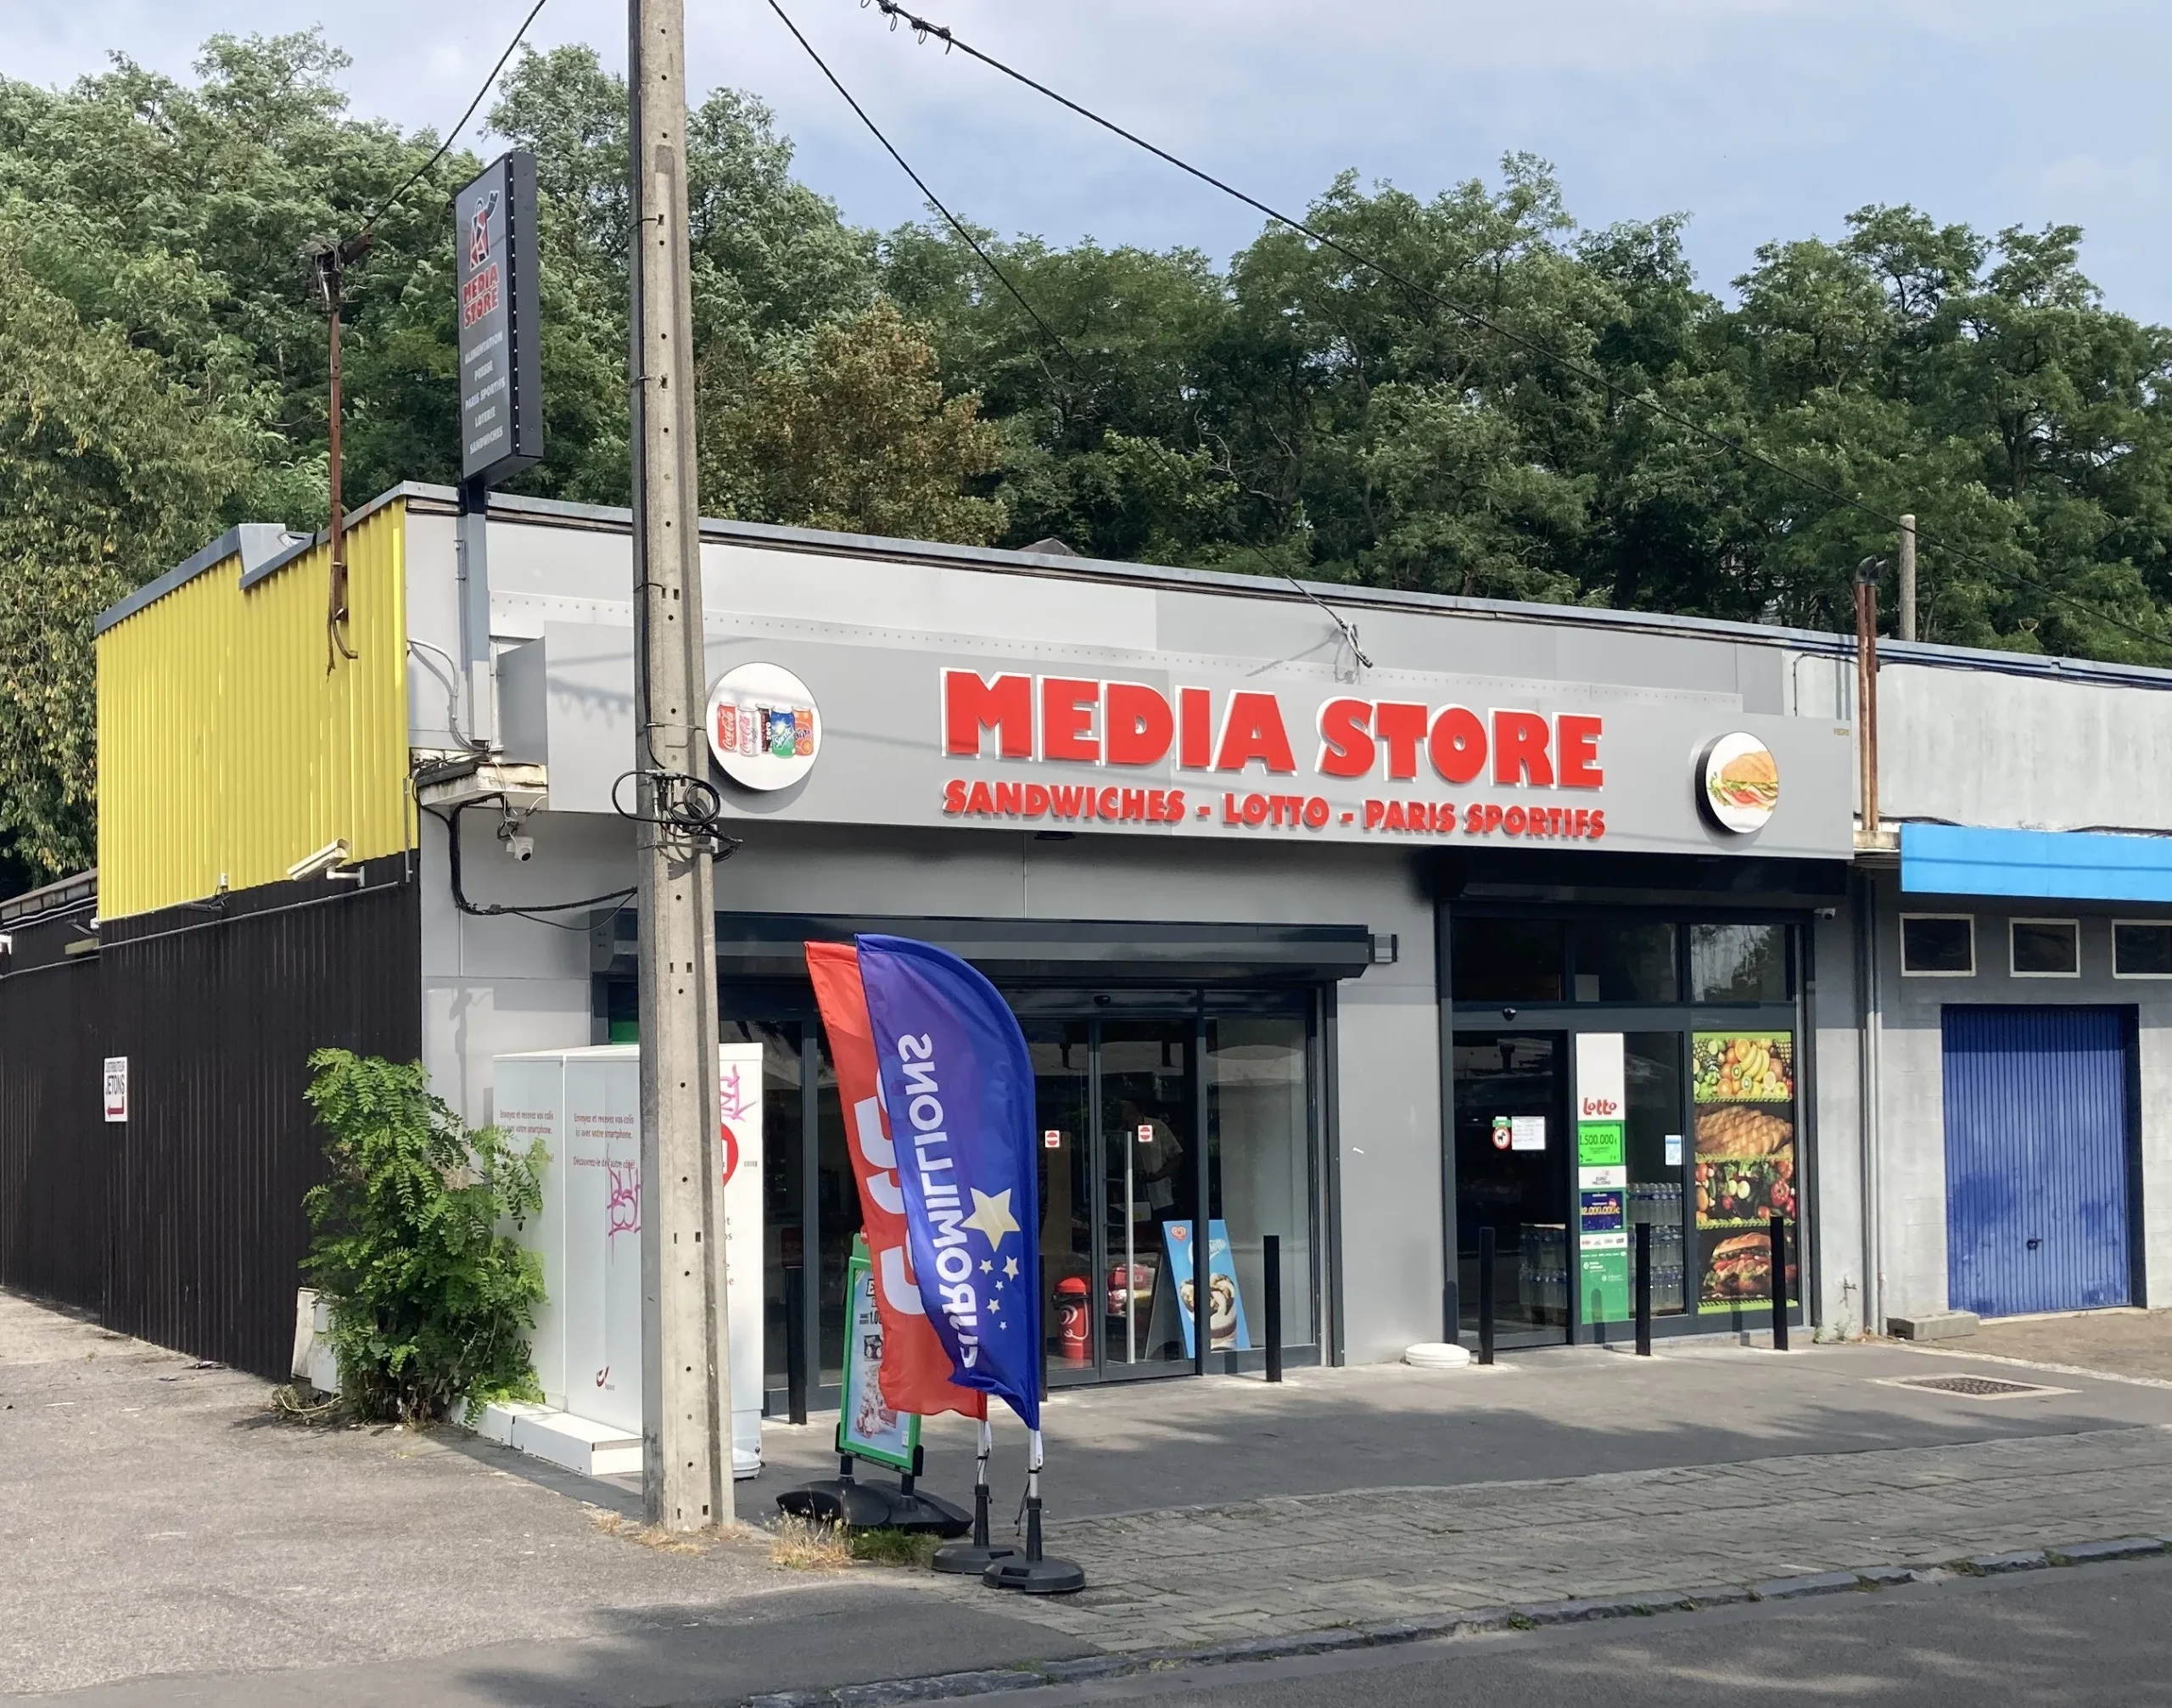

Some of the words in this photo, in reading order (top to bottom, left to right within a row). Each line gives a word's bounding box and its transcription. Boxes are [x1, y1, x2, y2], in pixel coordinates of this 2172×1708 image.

[462, 262, 500, 307] MEDIA
[463, 284, 500, 329] STORE
[465, 330, 502, 365] ALIMENTATION
[474, 360, 492, 381] PRESSE
[465, 392, 479, 411] PARIS
[480, 377, 505, 401] SPORTIFS
[475, 406, 495, 428] LOTERIE
[470, 425, 502, 455] SANDWICHES
[774, 726, 792, 748] Sprite
[940, 667, 1298, 777] MEDIA
[1314, 695, 1604, 792] STORE
[943, 778, 1186, 823] SANDWICHES
[1222, 792, 1330, 829] LOTTO
[1363, 798, 1457, 833] PARIS
[1463, 803, 1605, 839] SPORTIFS
